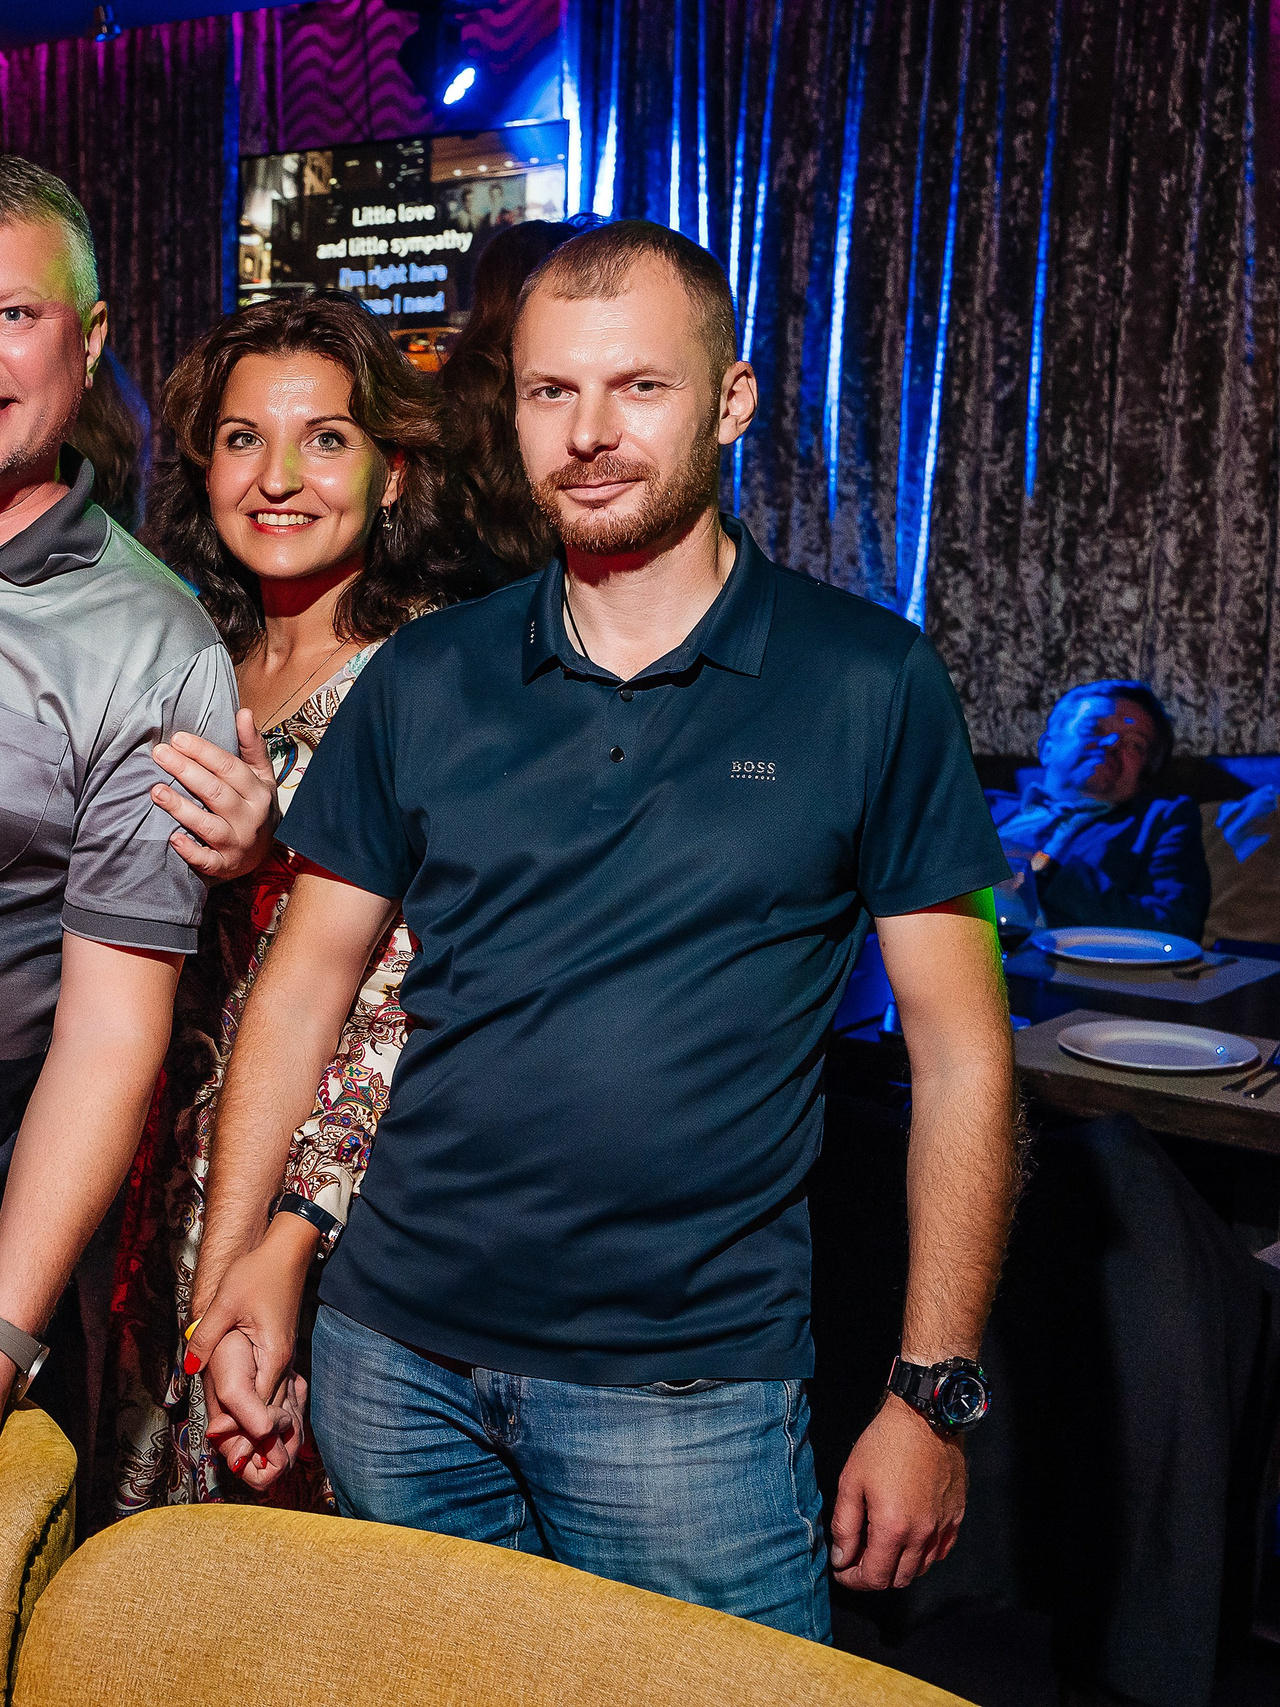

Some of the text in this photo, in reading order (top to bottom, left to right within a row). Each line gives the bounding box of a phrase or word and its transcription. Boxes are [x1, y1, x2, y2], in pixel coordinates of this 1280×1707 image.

[352, 203, 436, 227] Little love
[316, 229, 473, 260] and little sympathy
[367, 263, 408, 290] right
[409, 262, 448, 283] here
[402, 291, 445, 314] need
[731, 761, 776, 774] BOSS
